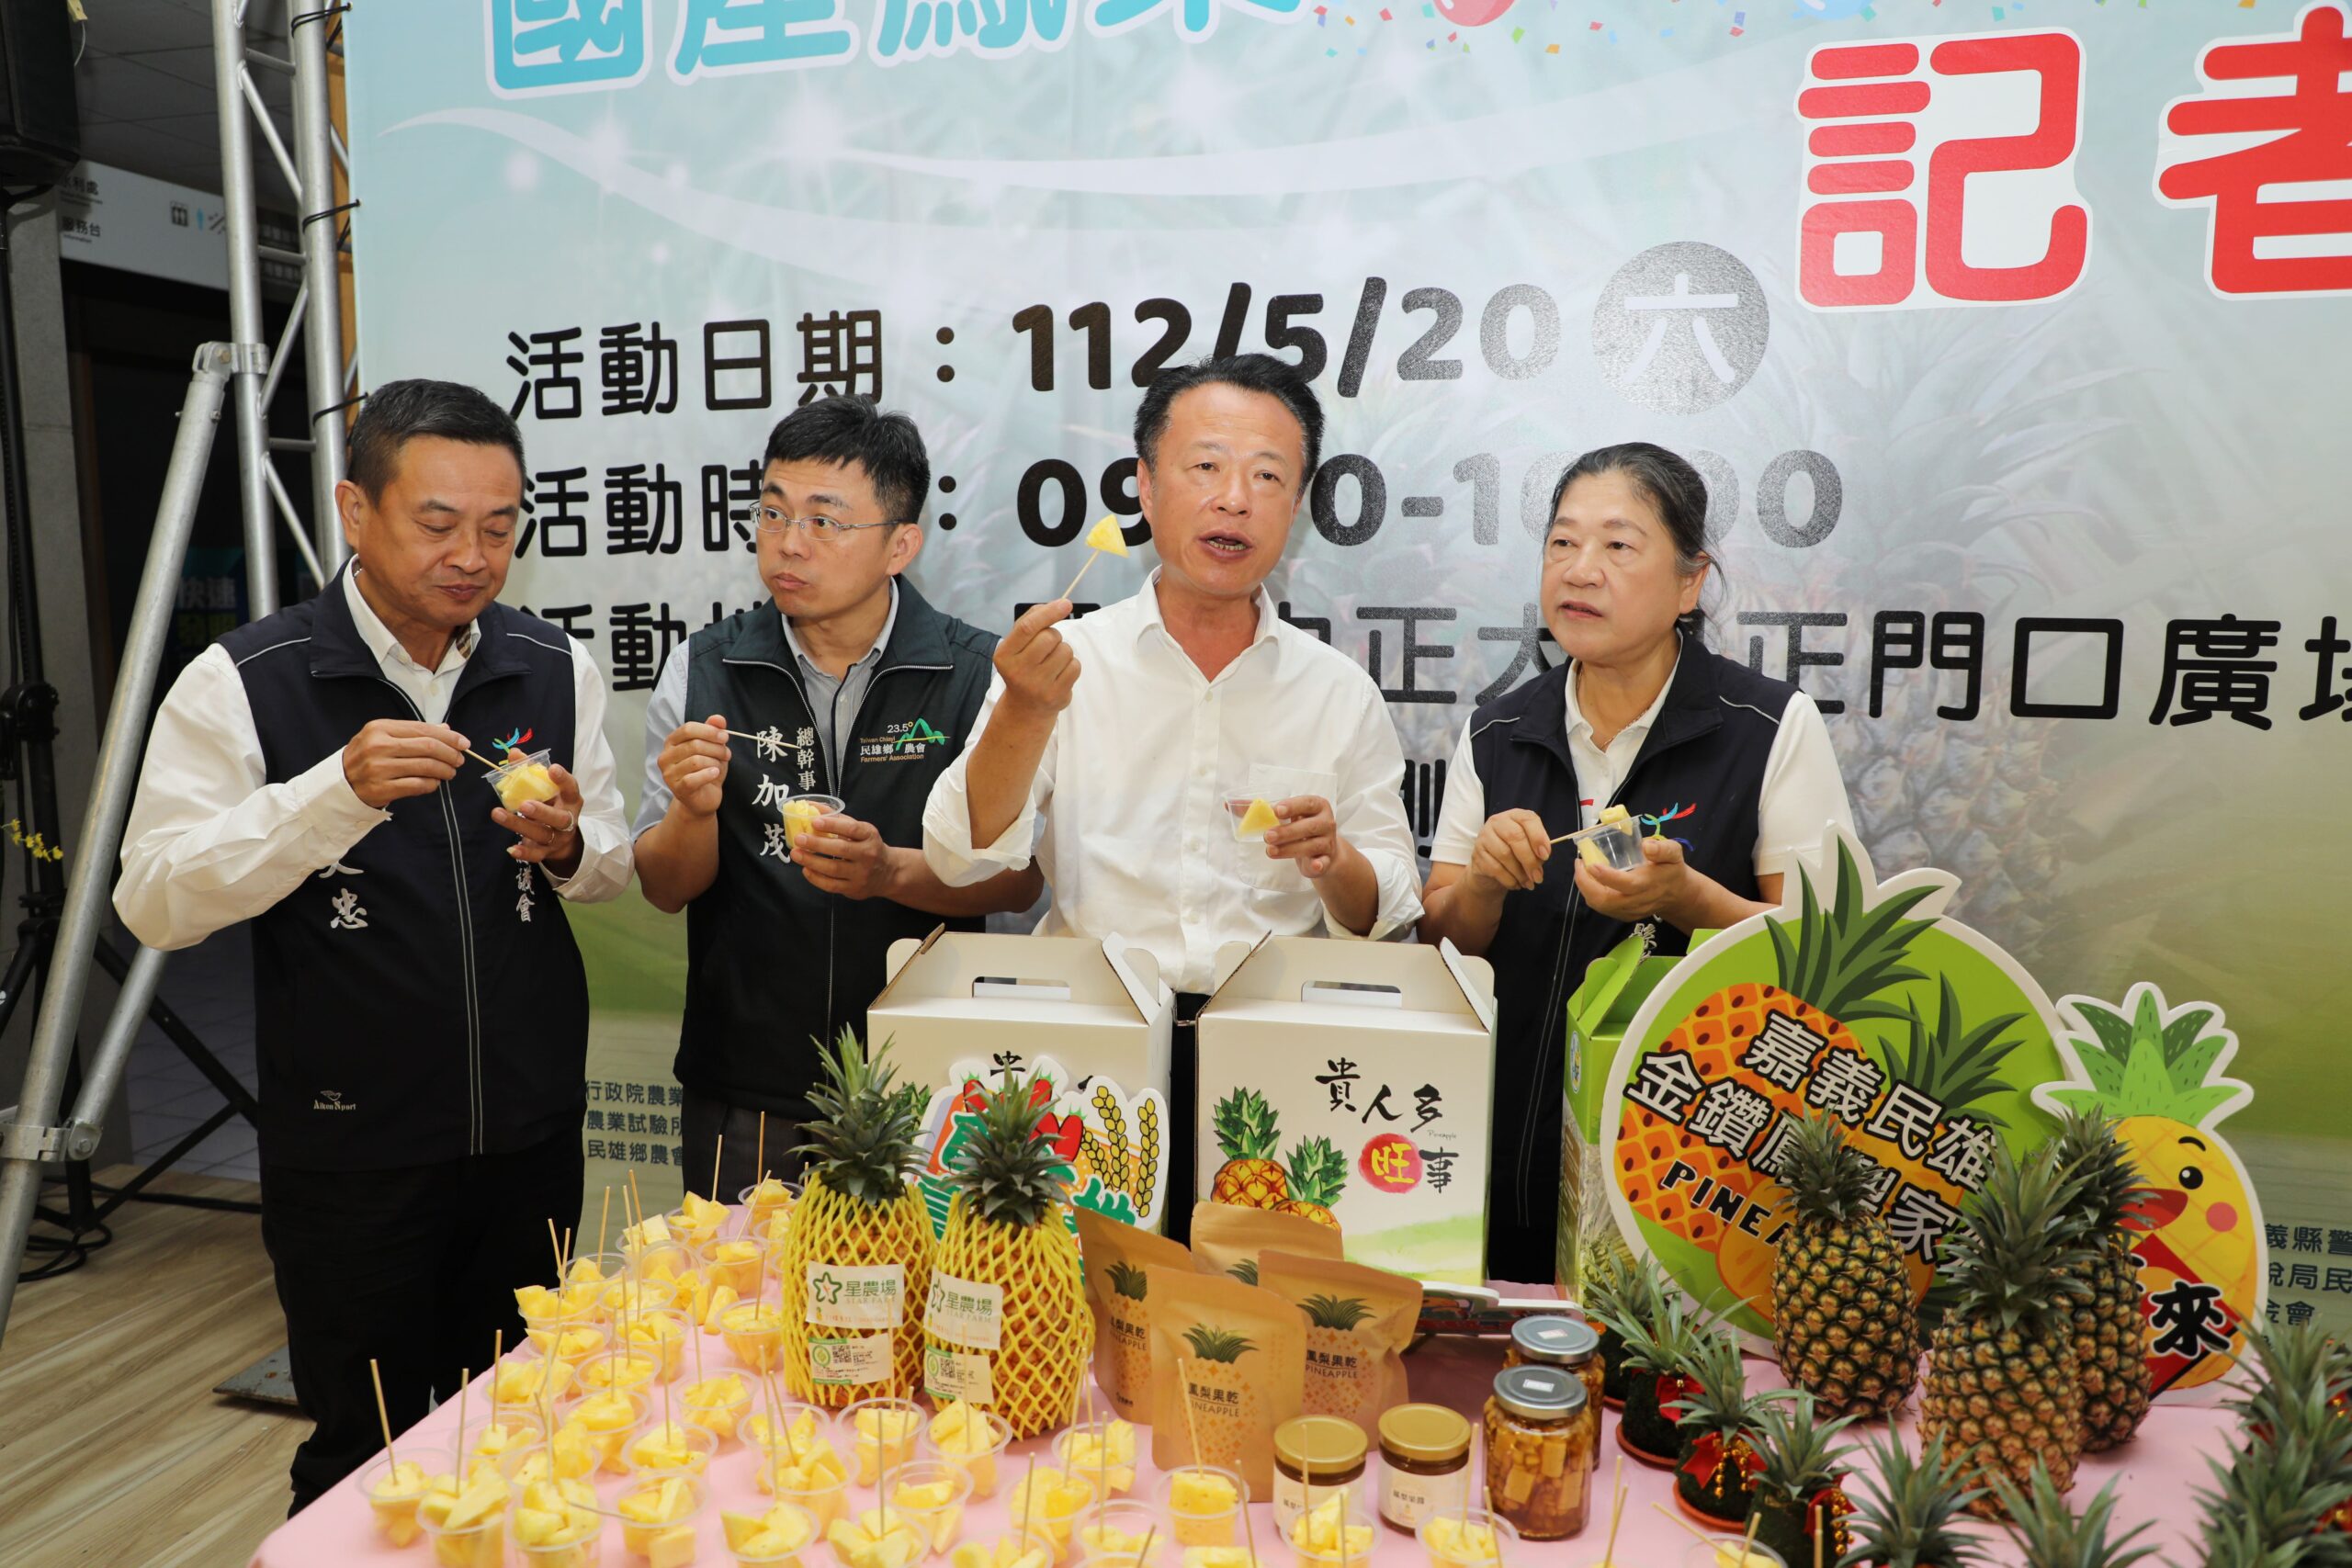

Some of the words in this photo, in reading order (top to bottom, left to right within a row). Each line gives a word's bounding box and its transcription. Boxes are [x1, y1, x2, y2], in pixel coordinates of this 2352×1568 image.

[1615, 266, 1744, 391] 六
[797, 727, 816, 791] 總幹事
[889, 753, 924, 761] Association
[752, 726, 791, 863] 陳加茂
[1315, 1057, 1442, 1133] 貴人多
[1745, 1010, 1998, 1191] 嘉義民雄
[844, 1279, 897, 1297] 星農場
[945, 1291, 992, 1316] 星農場
[1306, 1364, 1359, 1379] PINEAPPLE
[1191, 1401, 1239, 1417] INEAPPLE
